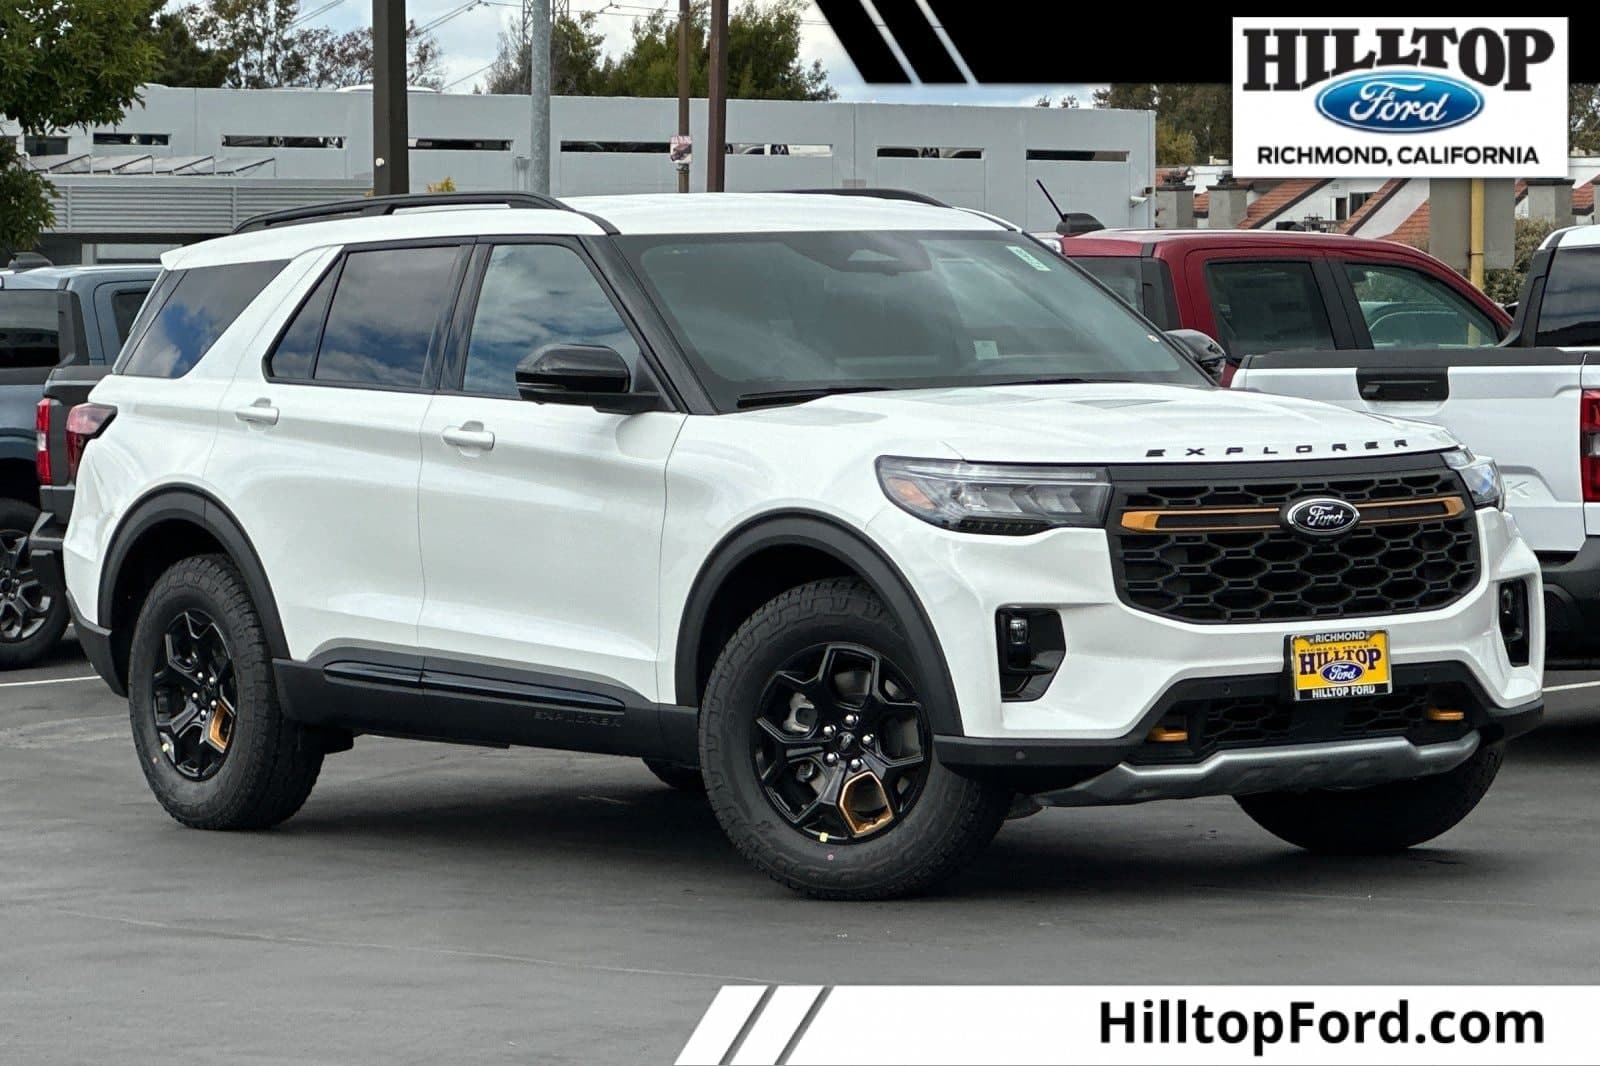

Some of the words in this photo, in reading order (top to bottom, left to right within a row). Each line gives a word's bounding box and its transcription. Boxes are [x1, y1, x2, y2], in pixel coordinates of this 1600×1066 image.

[1145, 439, 1408, 458] EXPLORER
[1307, 505, 1344, 526] Ford
[1316, 631, 1365, 643] RICHMOND
[1299, 648, 1382, 675] HILLTOP
[1329, 664, 1356, 680] Ford
[1312, 688, 1348, 699] HILLTOP
[1352, 685, 1375, 697] FORD
